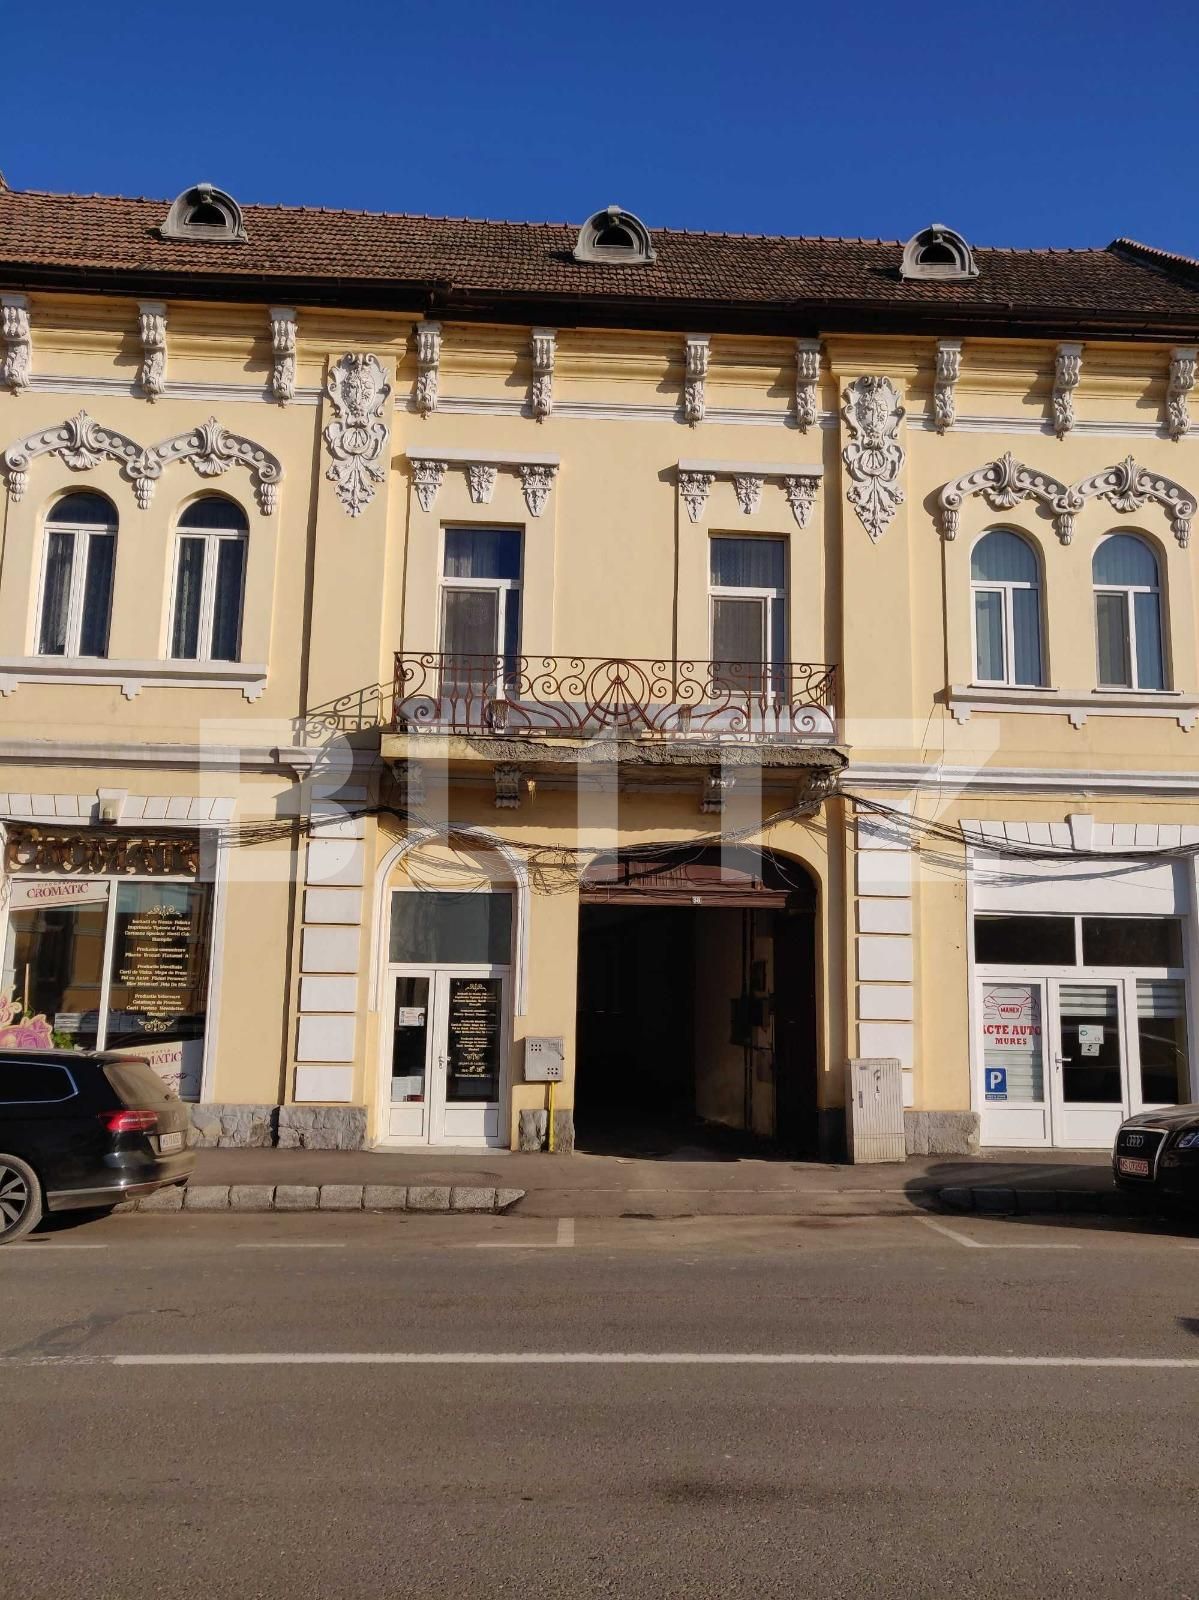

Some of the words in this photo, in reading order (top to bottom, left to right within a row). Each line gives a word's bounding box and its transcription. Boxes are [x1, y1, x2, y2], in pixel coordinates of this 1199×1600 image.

[27, 883, 89, 898] CROMATIC
[1012, 1025, 1041, 1036] AUTO
[995, 1037, 1027, 1045] MURES
[990, 1071, 1002, 1090] P
